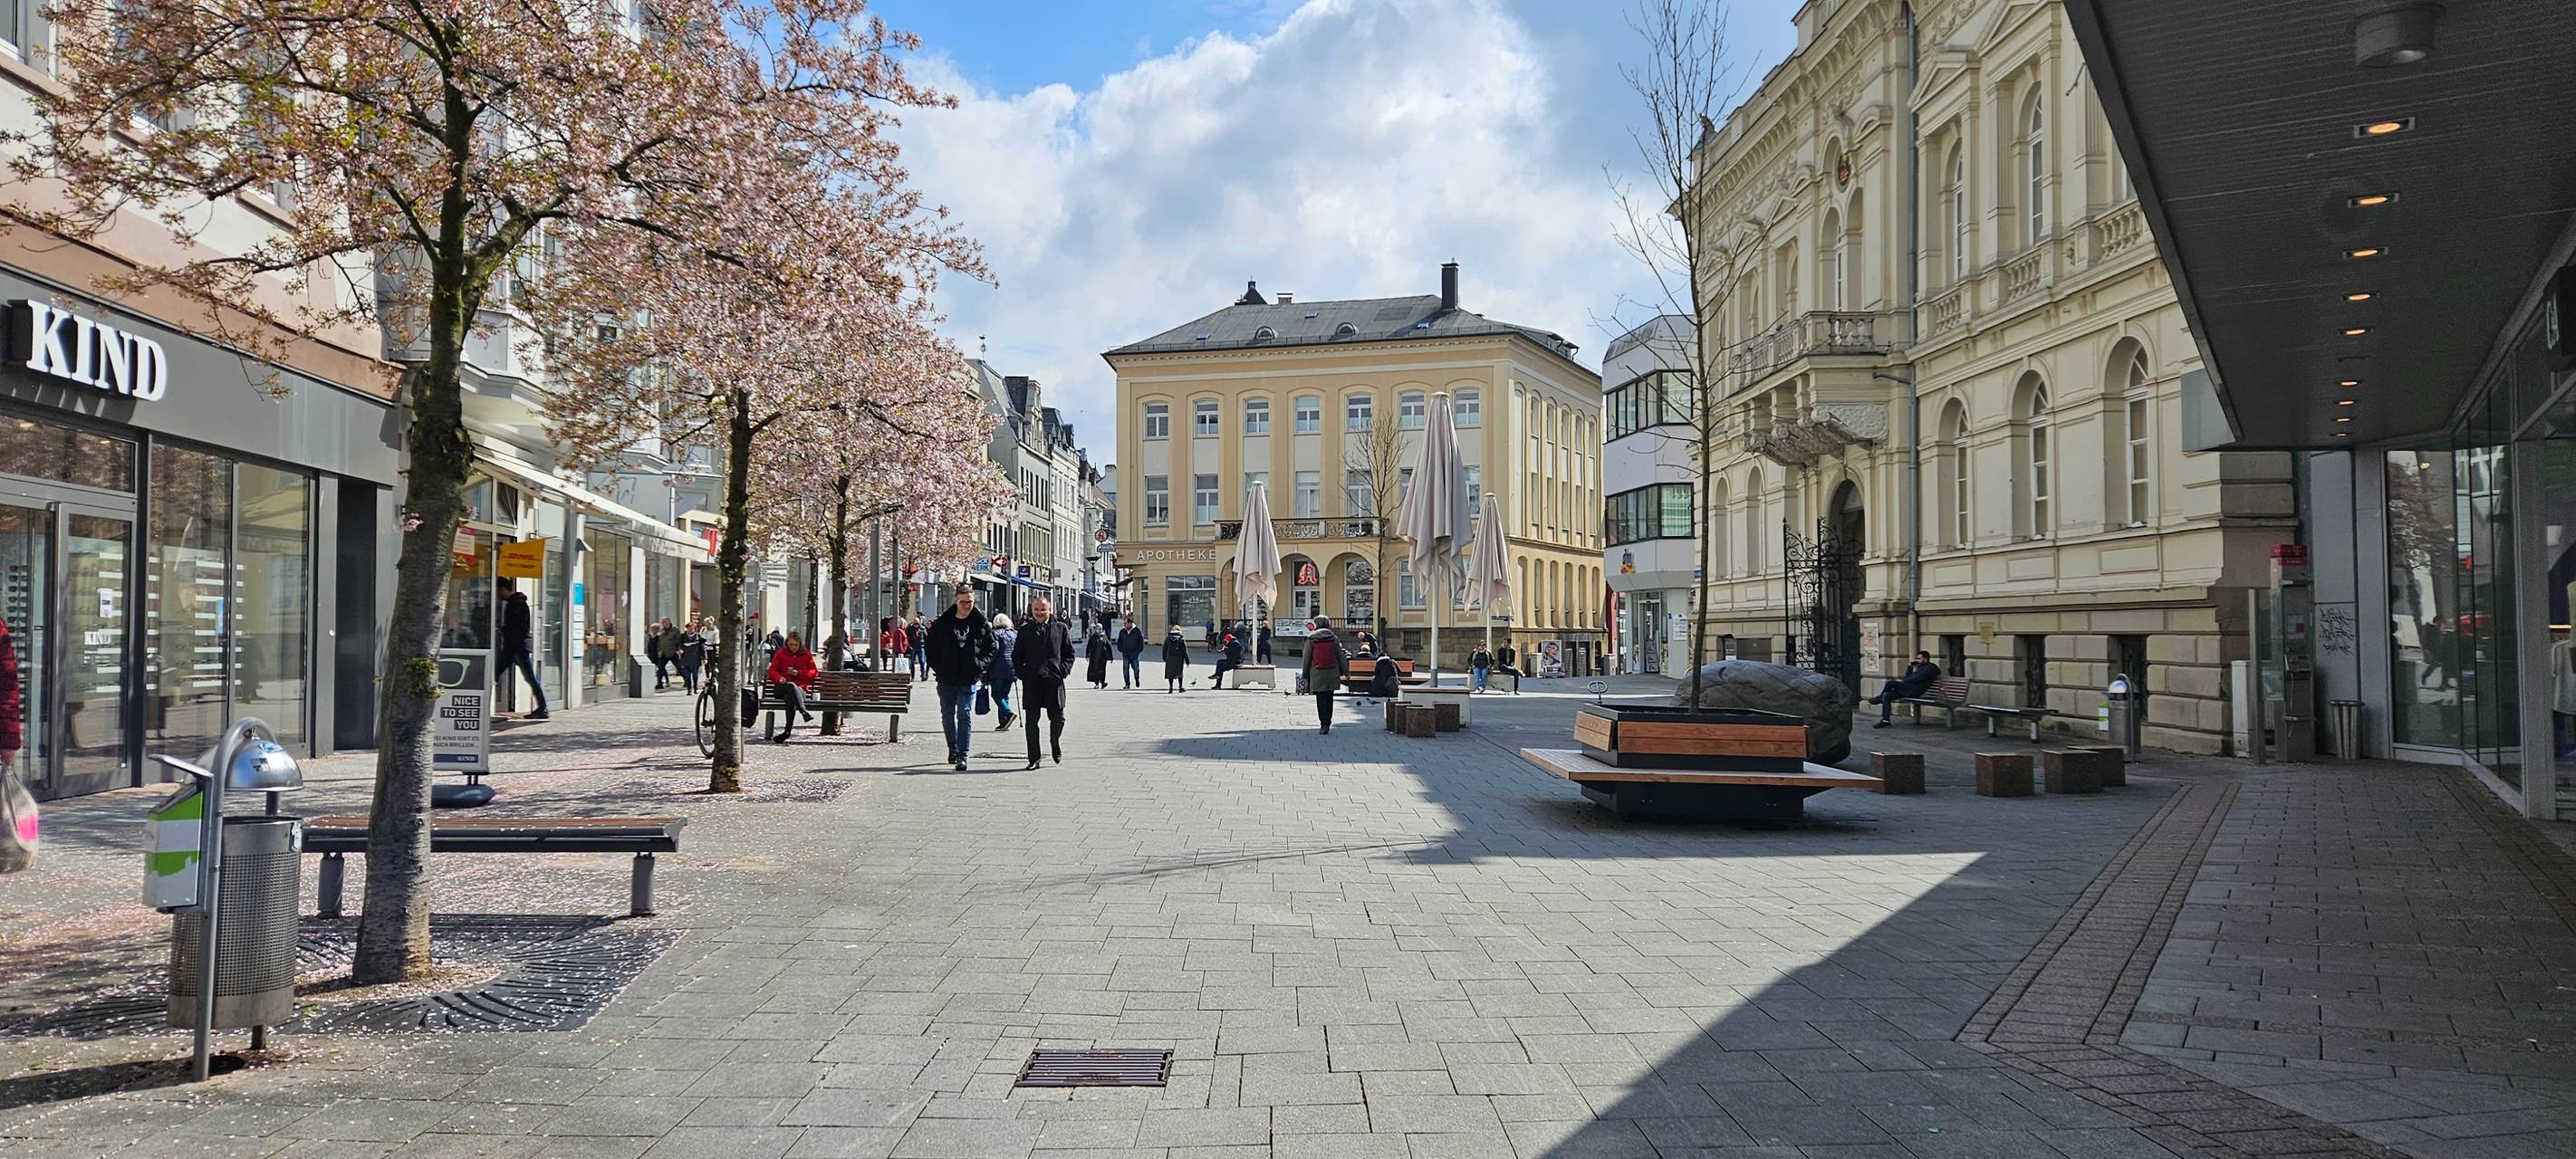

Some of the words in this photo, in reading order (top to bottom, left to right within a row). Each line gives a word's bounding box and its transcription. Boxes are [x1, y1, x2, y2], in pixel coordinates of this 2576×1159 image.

[26, 299, 167, 402] KIND
[1137, 550, 1216, 560] APOTHEKE
[454, 696, 479, 705] NICE
[443, 708, 456, 717] TO
[457, 708, 479, 717] SEE
[457, 721, 477, 730] YOU
